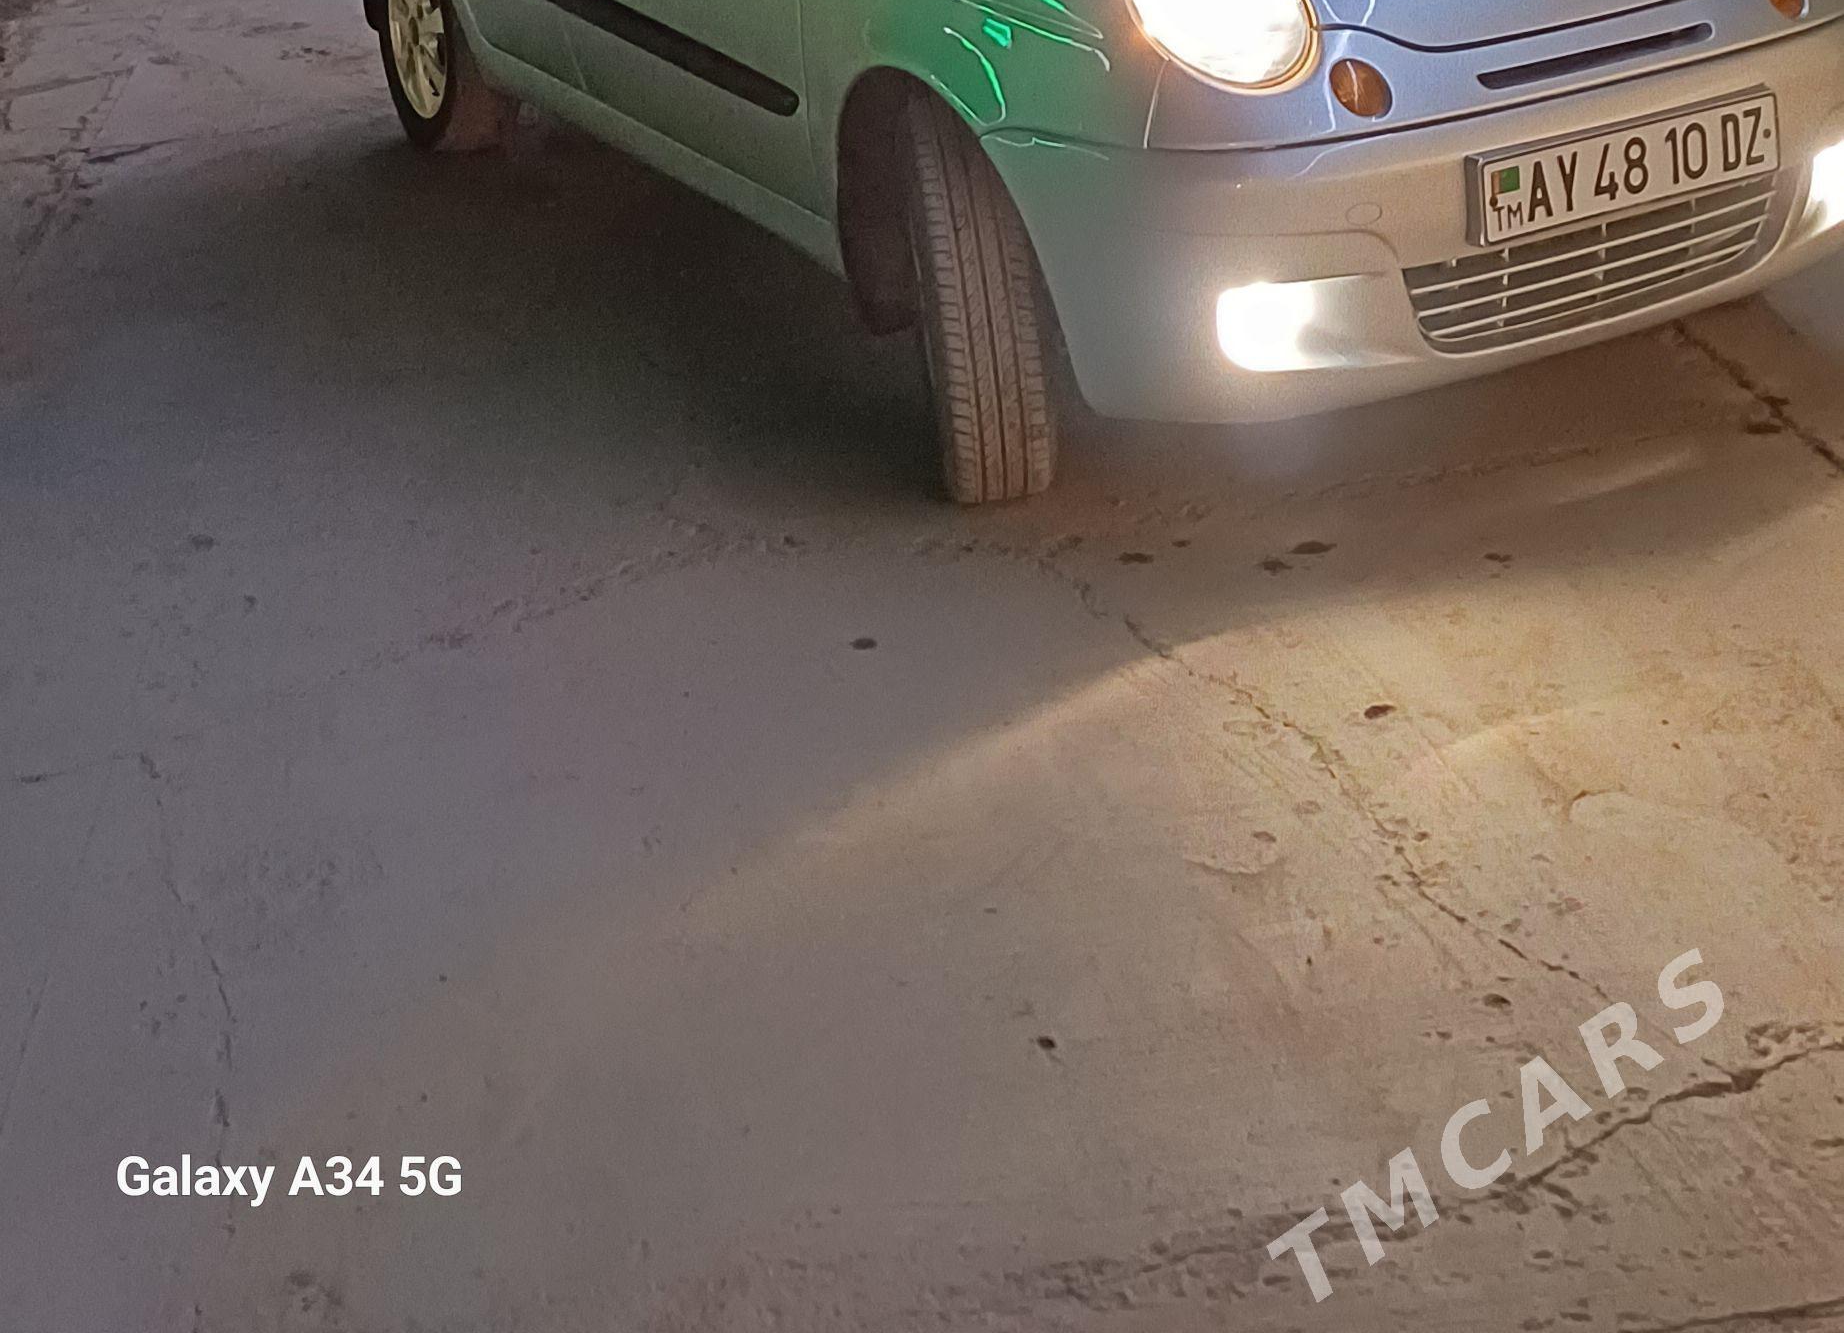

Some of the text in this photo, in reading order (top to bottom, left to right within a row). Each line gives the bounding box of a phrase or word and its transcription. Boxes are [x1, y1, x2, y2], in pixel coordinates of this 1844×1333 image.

[1527, 106, 1765, 222] AY 48 10 DZ
[1494, 200, 1524, 232] TM
